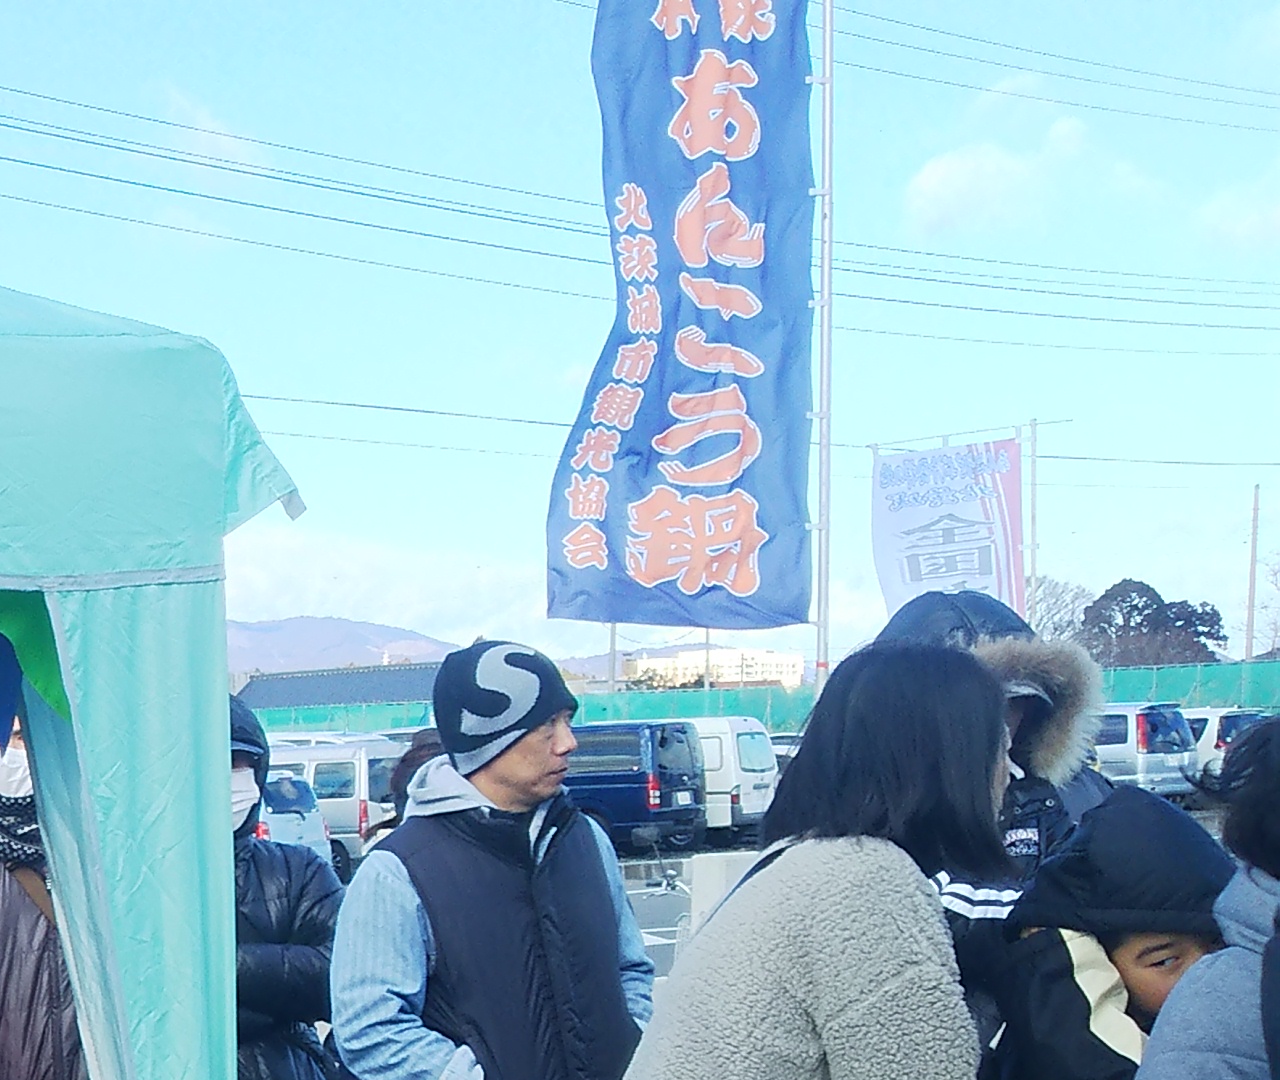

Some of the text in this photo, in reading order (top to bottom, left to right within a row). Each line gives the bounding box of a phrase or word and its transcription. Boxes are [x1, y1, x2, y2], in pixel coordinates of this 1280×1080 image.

[562, 182, 664, 570] 北茨城市観光協会
[626, 48, 769, 598] あんこう鍋
